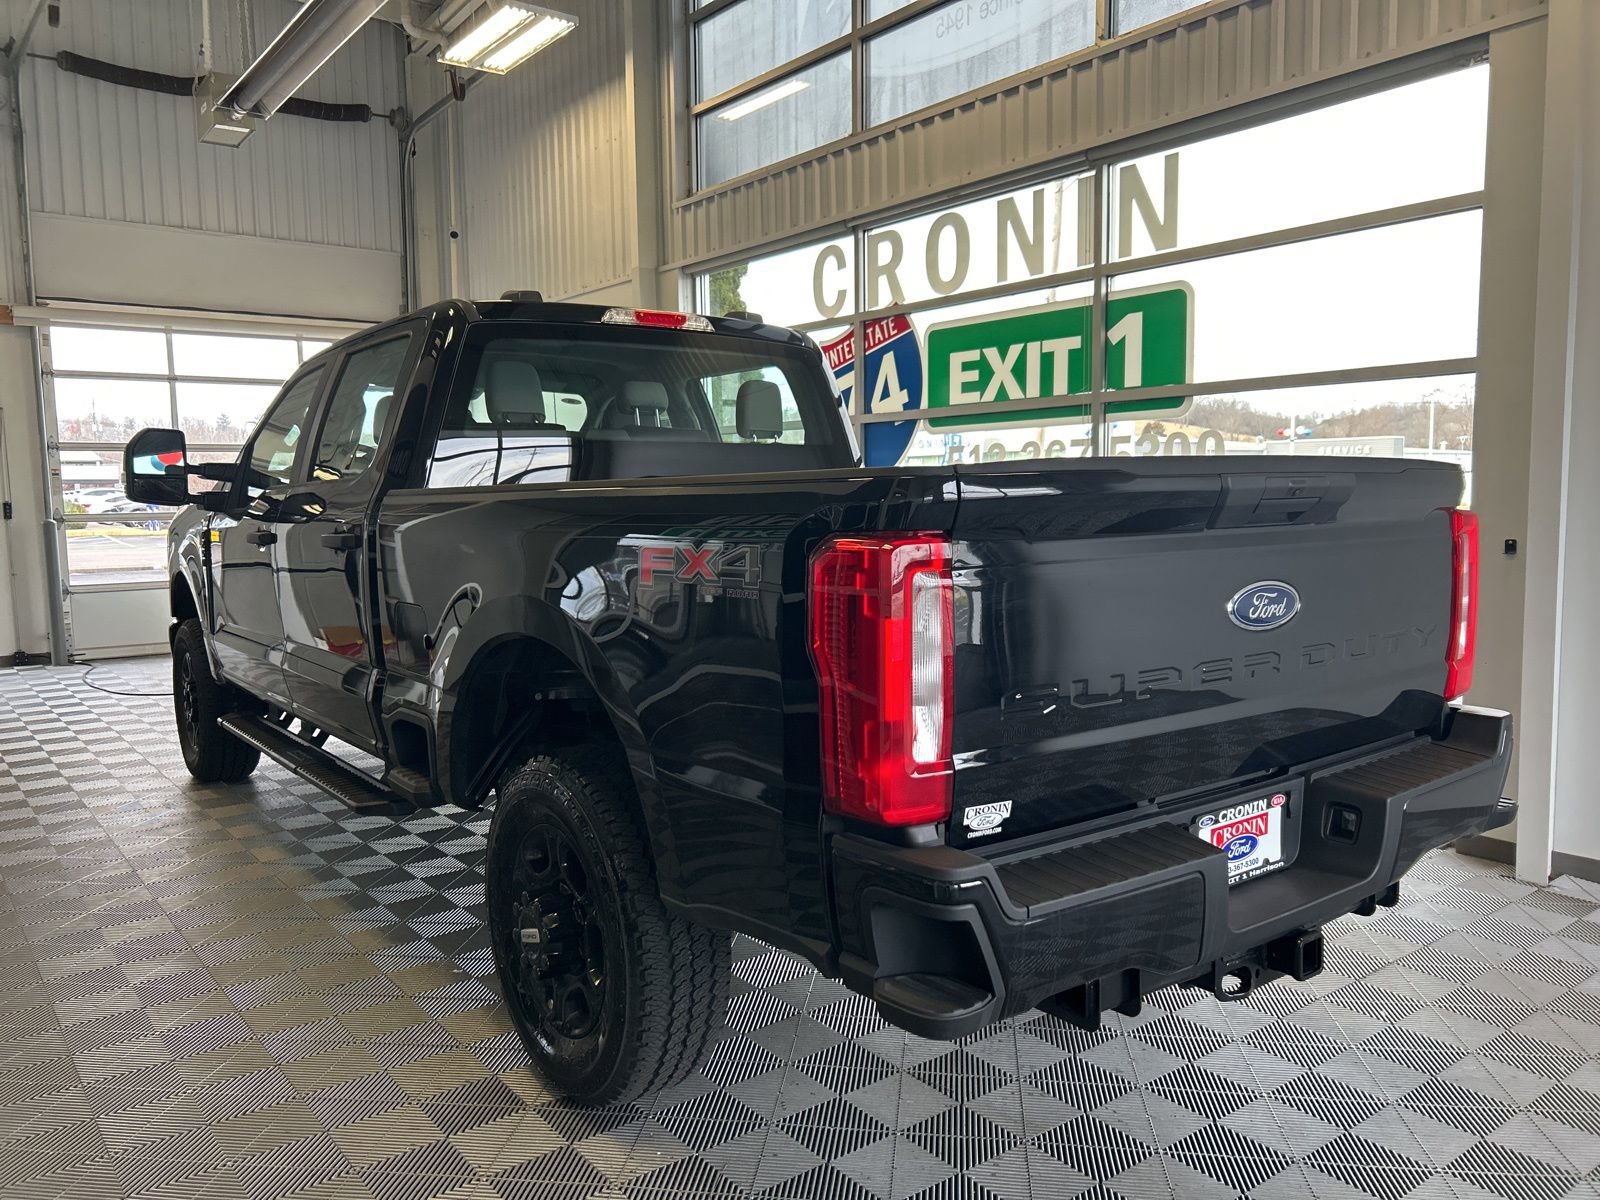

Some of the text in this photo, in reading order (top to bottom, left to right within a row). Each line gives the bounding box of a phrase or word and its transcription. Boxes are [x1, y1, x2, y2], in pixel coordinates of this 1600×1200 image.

[813, 152, 1180, 319] CRONIN
[826, 317, 898, 368] INTETATE
[949, 311, 1144, 406] EXIT 1
[638, 543, 761, 590] FX4
[1249, 592, 1288, 619] Ford
[1001, 623, 1438, 721] SUPER DUTY
[966, 803, 1011, 820] CRONIN
[1218, 798, 1267, 823] CRONIN
[1213, 815, 1267, 848] CRONIN
[1228, 838, 1252, 858] Ford
[1249, 861, 1285, 877] Harrison
